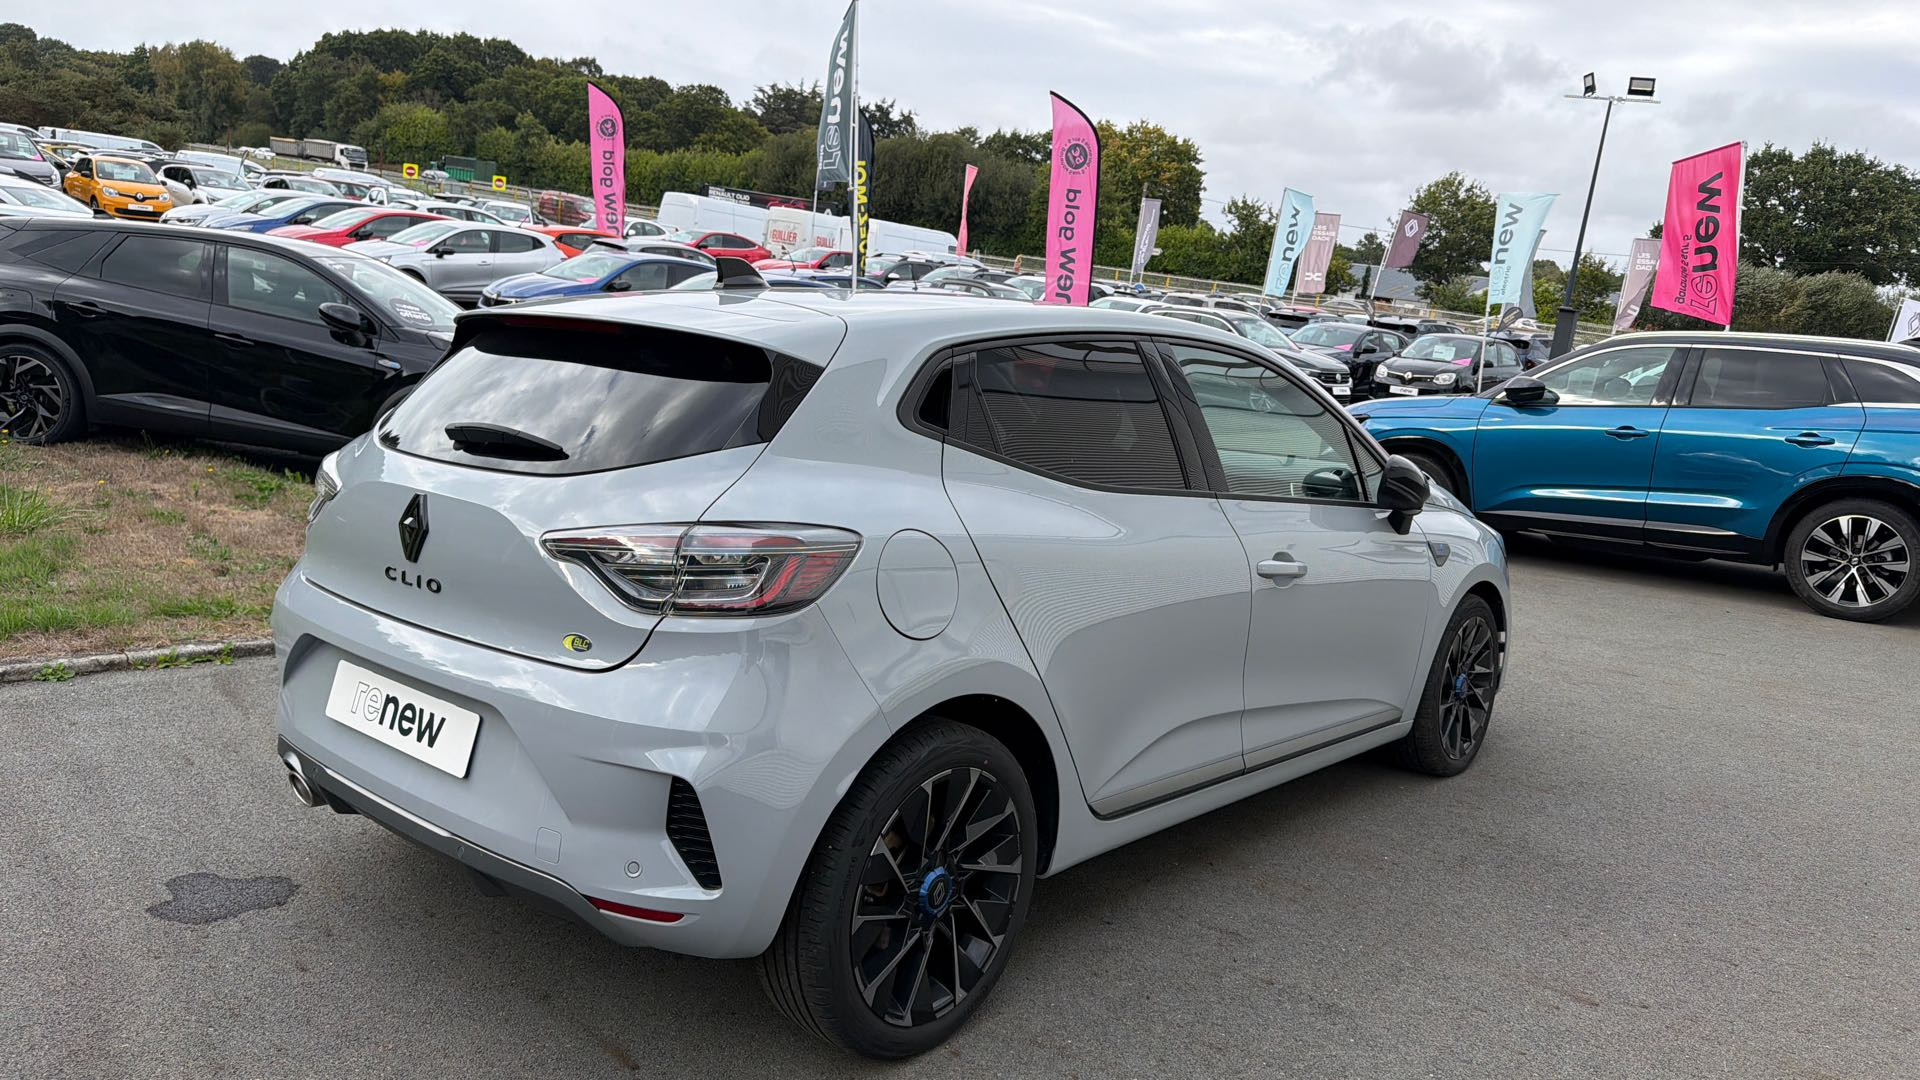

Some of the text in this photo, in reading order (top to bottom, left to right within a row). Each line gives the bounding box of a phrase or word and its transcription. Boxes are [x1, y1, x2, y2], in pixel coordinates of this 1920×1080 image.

[772, 229, 797, 242] GUILLIER
[1275, 206, 1300, 289] renew
[384, 565, 442, 594] CLIO
[573, 637, 589, 648] BLC
[350, 679, 446, 749] renew
